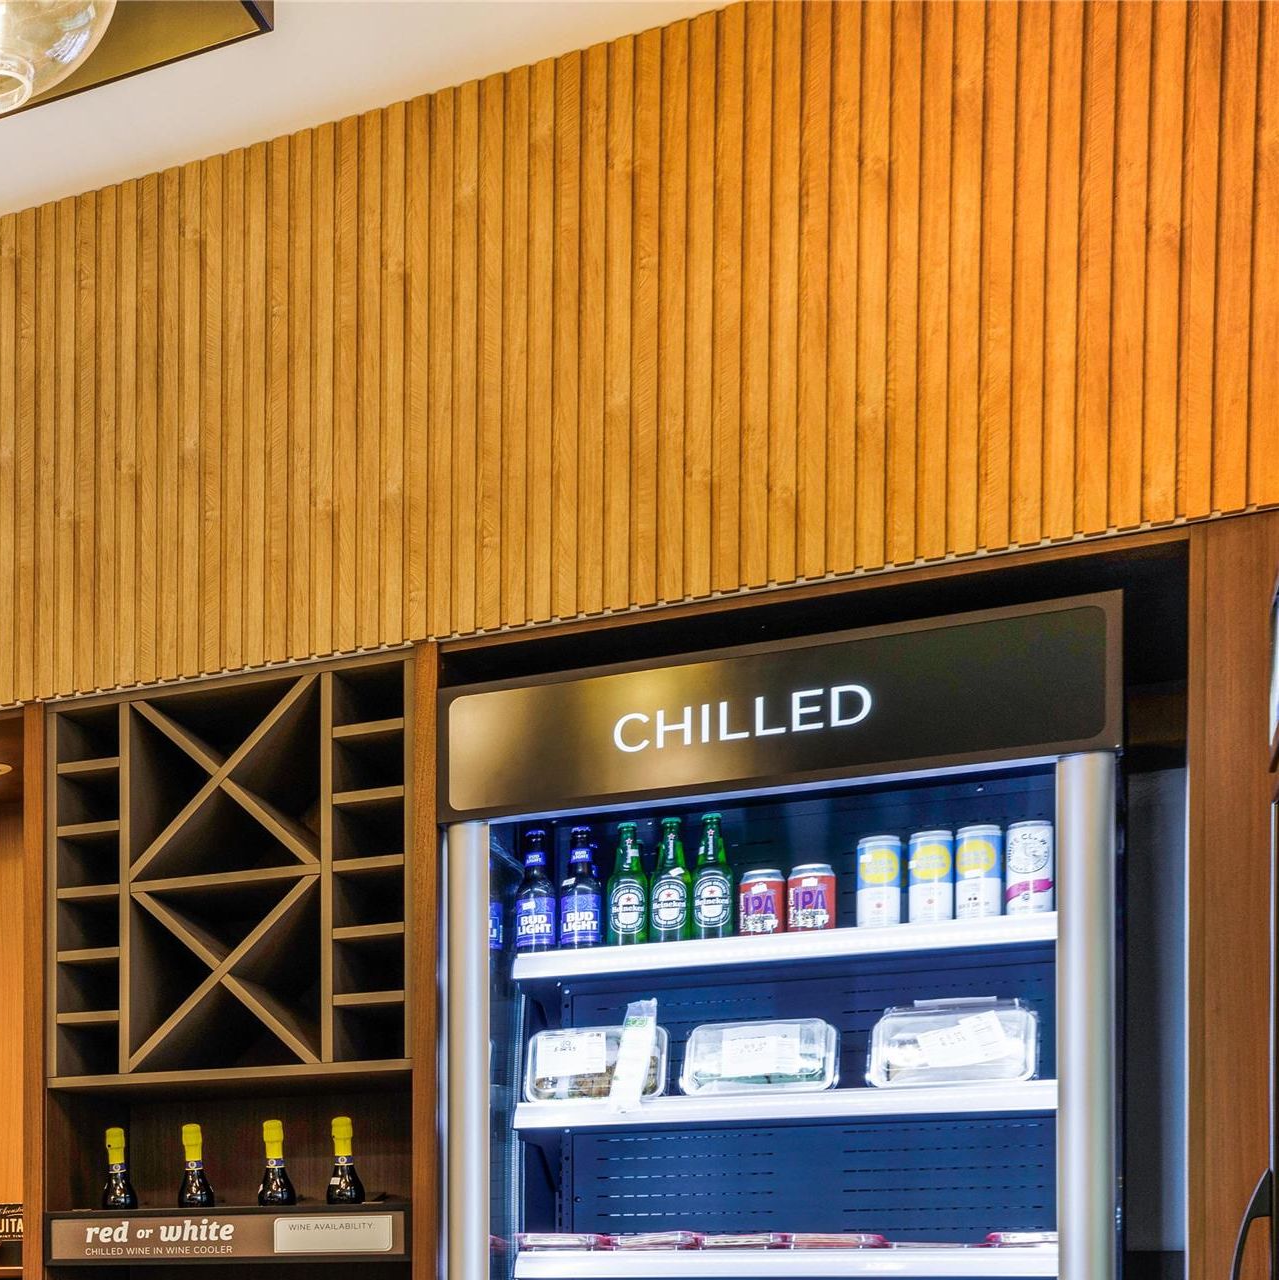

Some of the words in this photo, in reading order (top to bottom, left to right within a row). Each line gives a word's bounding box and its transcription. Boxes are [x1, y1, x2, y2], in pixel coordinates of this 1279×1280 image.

[612, 684, 874, 754] CHILLED
[745, 895, 775, 916] IPA
[795, 890, 827, 910] IPA
[521, 914, 547, 925] BUD
[566, 911, 594, 922] BUD
[518, 924, 551, 935] LIGHT
[563, 921, 598, 932] LIGHT
[85, 1221, 128, 1243] red
[136, 1227, 153, 1239] or
[159, 1218, 235, 1242] white
[288, 1223, 311, 1231] WINE
[85, 1247, 123, 1256] CHILLED
[126, 1246, 150, 1255] WINE
[153, 1246, 162, 1254] IN
[165, 1246, 190, 1254] WINE
[193, 1245, 233, 1254] COOLER
